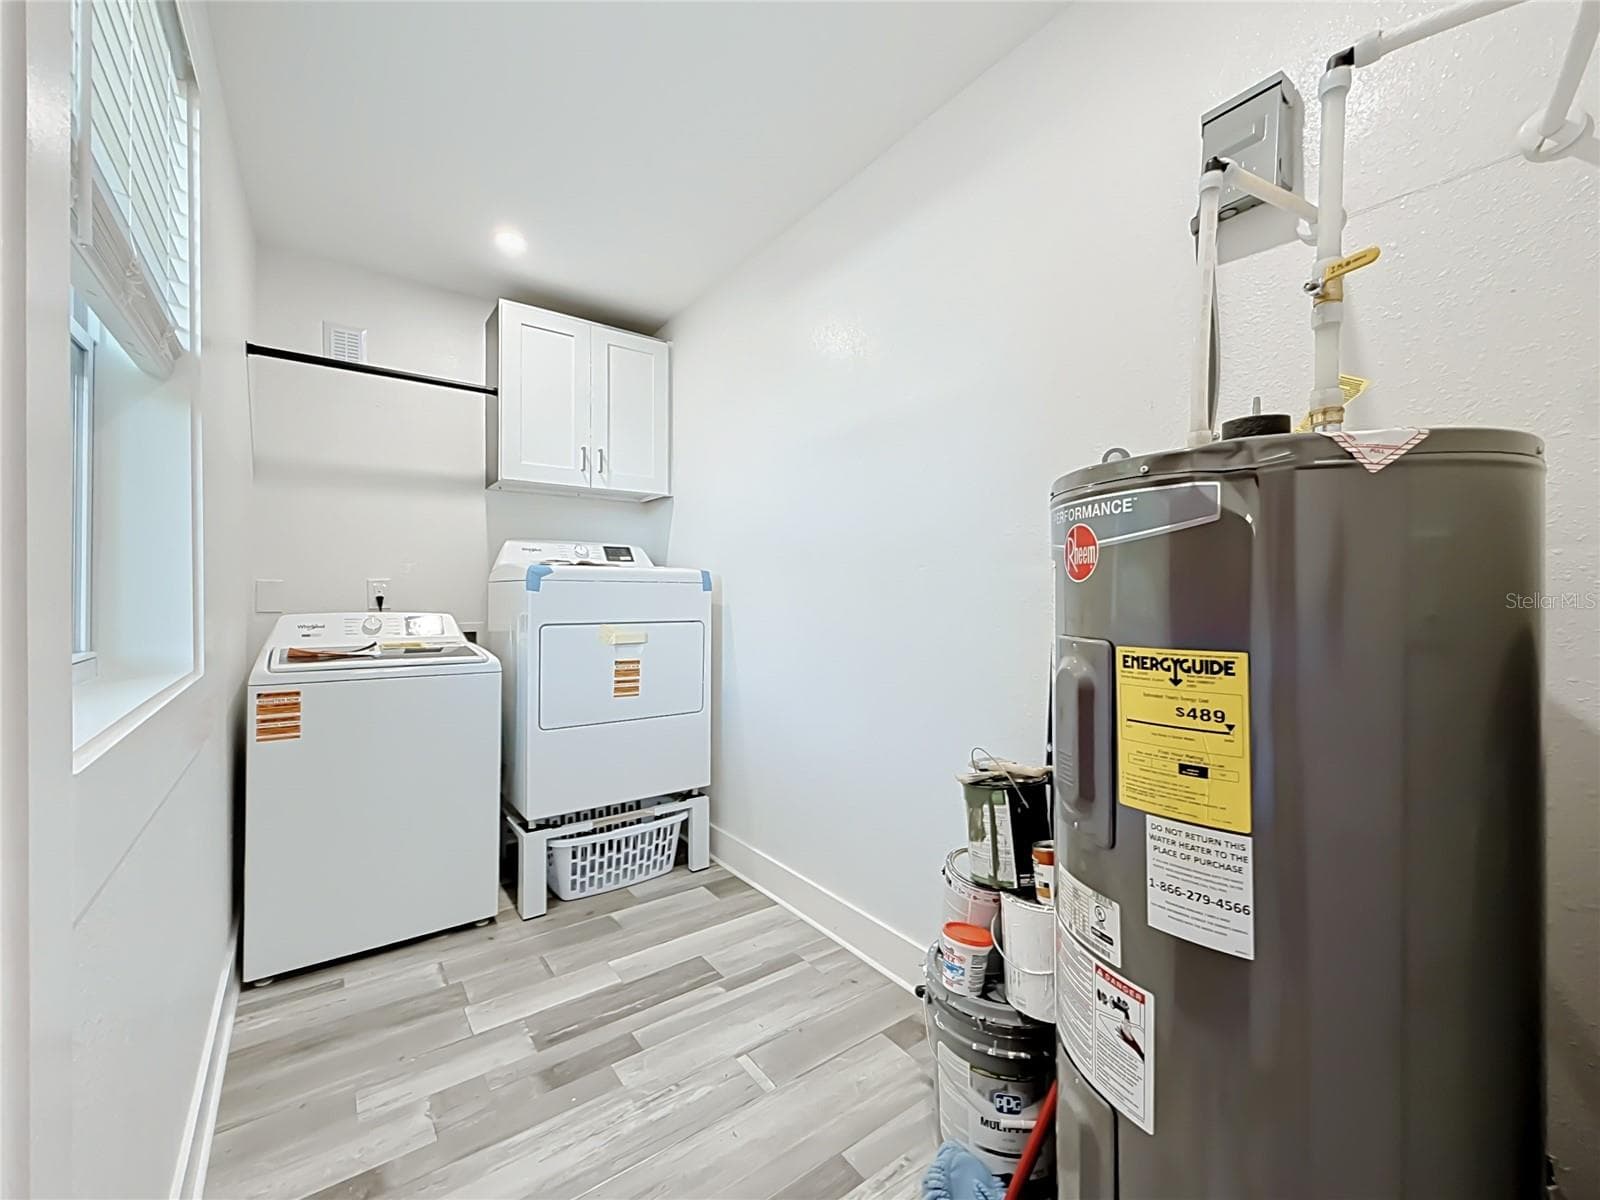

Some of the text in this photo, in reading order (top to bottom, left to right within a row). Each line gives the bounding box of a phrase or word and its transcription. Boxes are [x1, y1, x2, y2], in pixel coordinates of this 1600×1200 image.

[1067, 527, 1096, 573] Rheem
[1122, 654, 1236, 677] ENERGYGUIDE
[1149, 833, 1249, 864] WATER HEATER TO THE
[1150, 822, 1246, 852] DO NOT RETURN THIS
[1153, 845, 1244, 874] PLACE OF PURCHASE
[1149, 878, 1251, 916] 1-866-279-4566
[996, 1096, 1021, 1113] PPG
